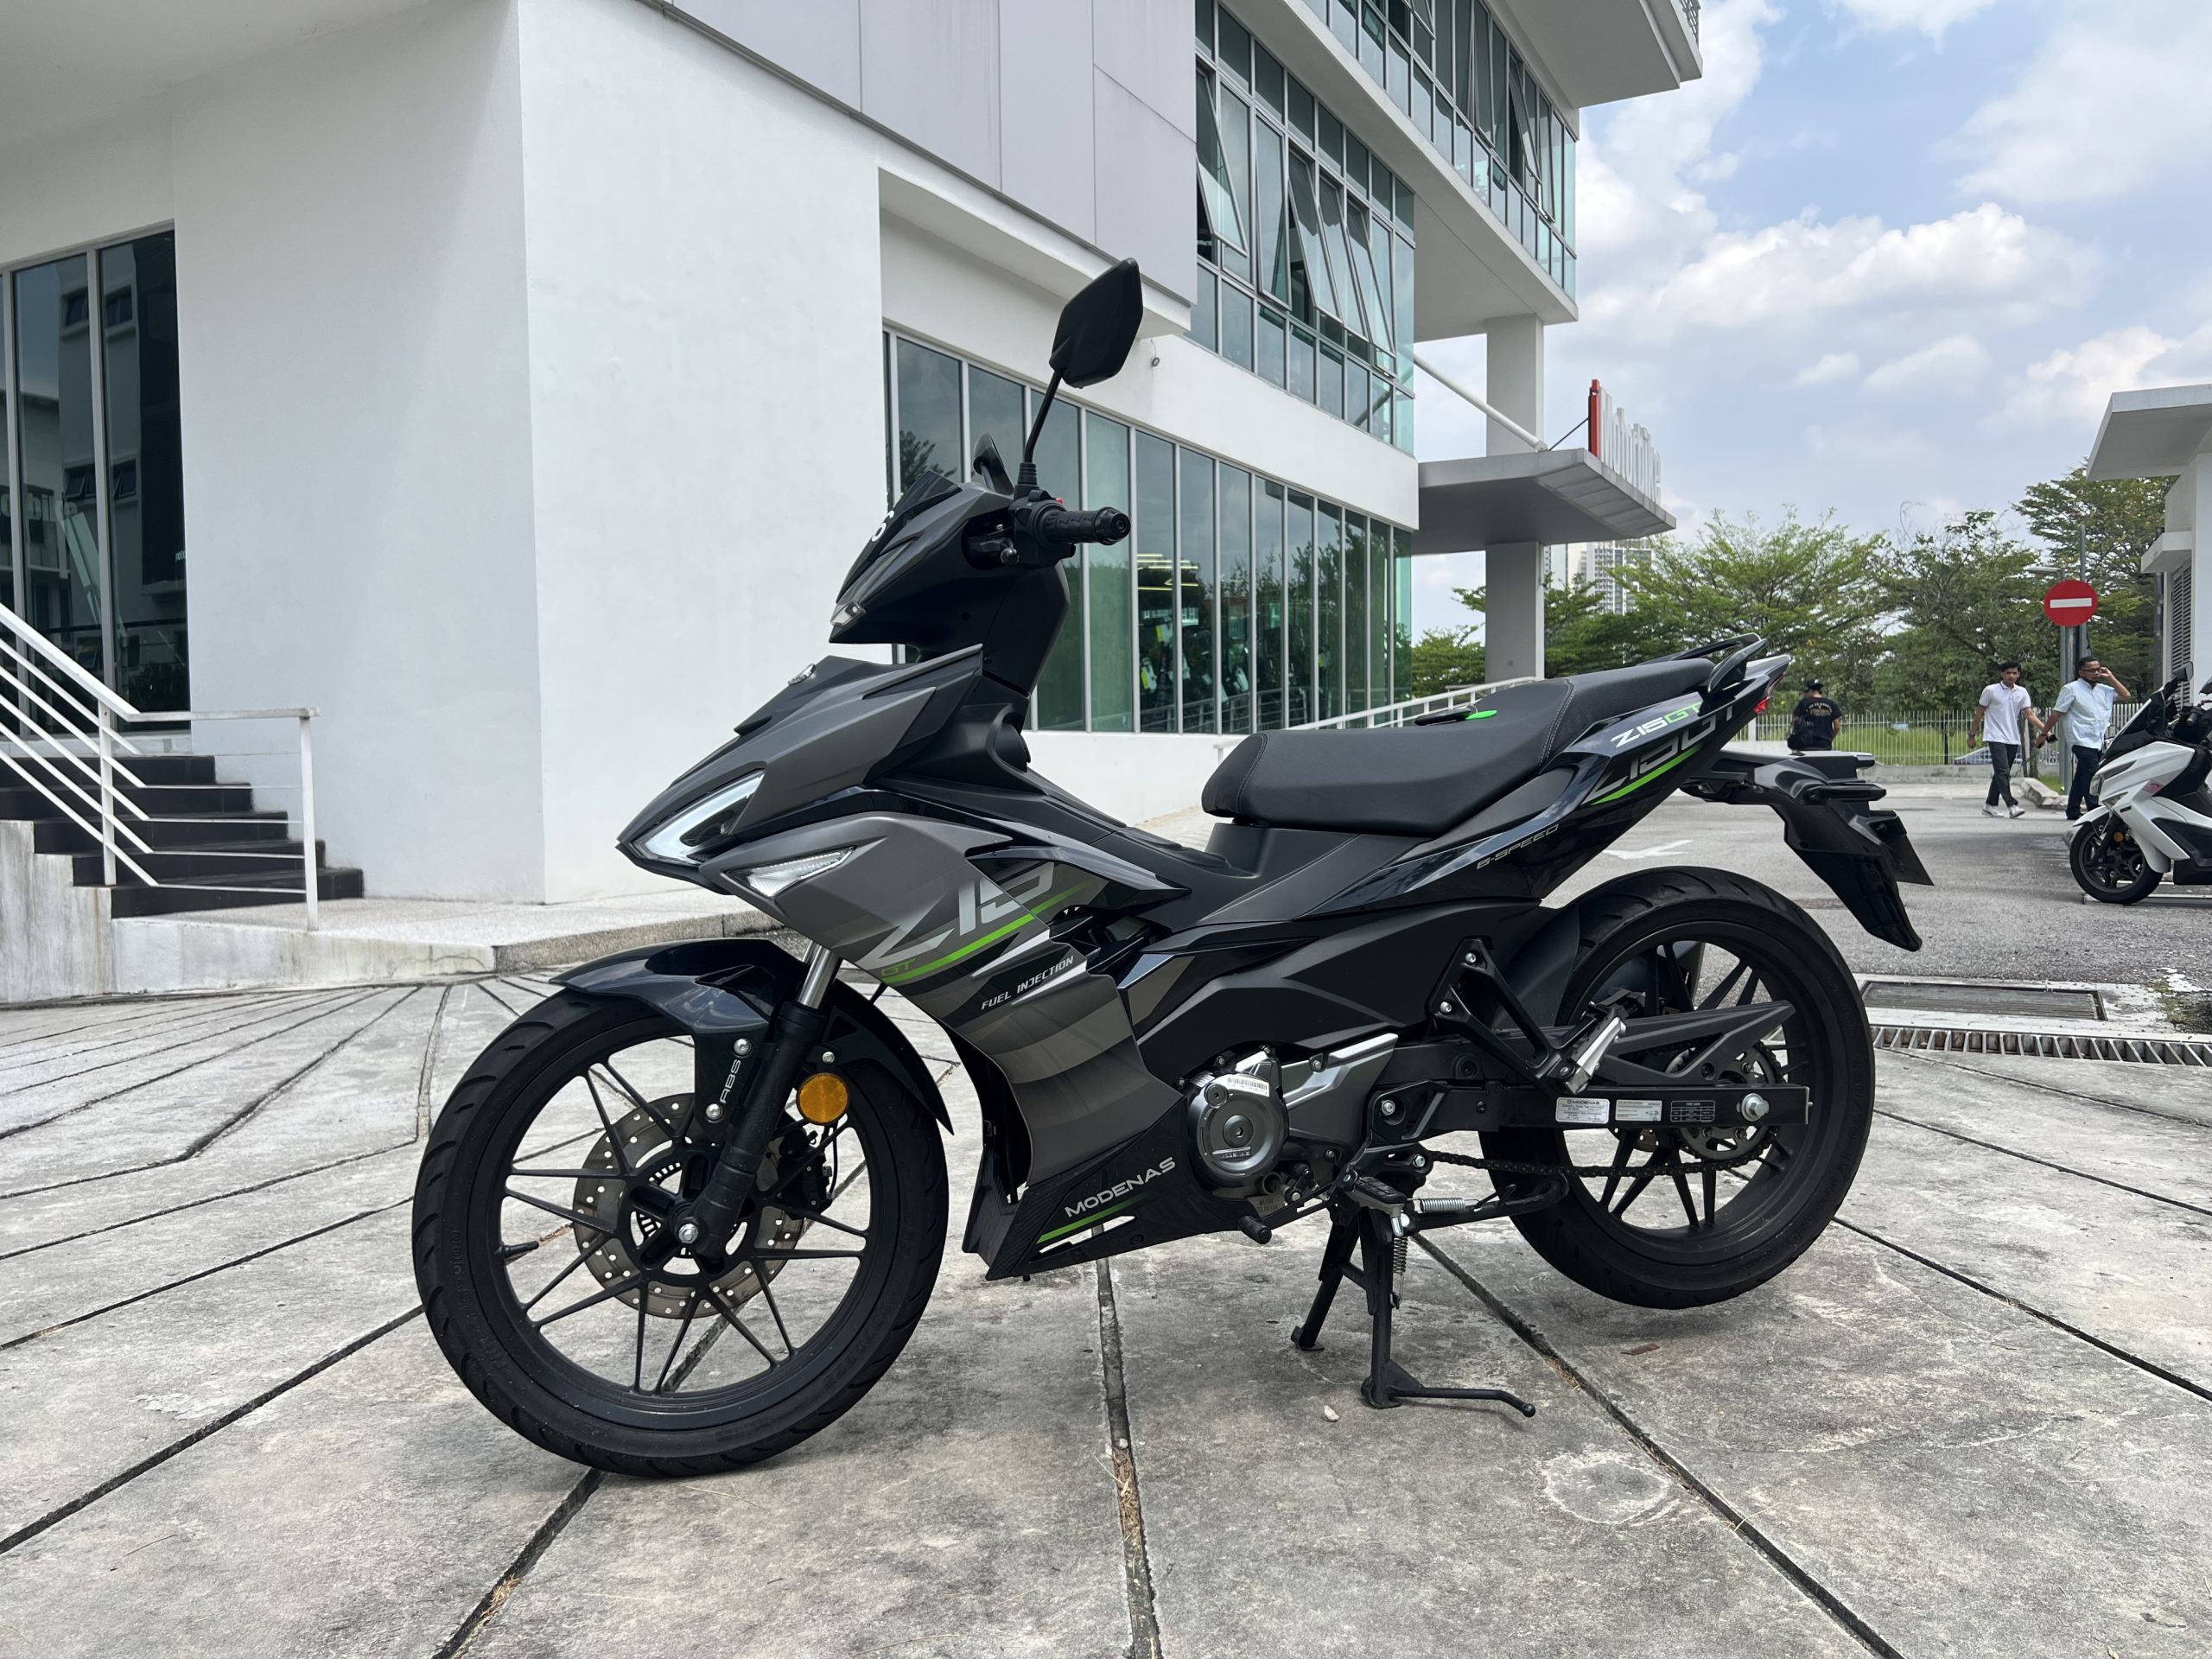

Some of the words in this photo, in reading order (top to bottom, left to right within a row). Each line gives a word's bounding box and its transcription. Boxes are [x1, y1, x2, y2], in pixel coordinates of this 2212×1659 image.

[1610, 701, 1701, 748] Z15GT
[1476, 823, 1560, 870] 6-SPEED
[880, 957, 917, 977] GT
[981, 991, 1012, 1010] FUEL
[1016, 955, 1074, 994] INJECTION
[720, 1059, 741, 1103] ABS
[1064, 1156, 1176, 1217] MODENAS
